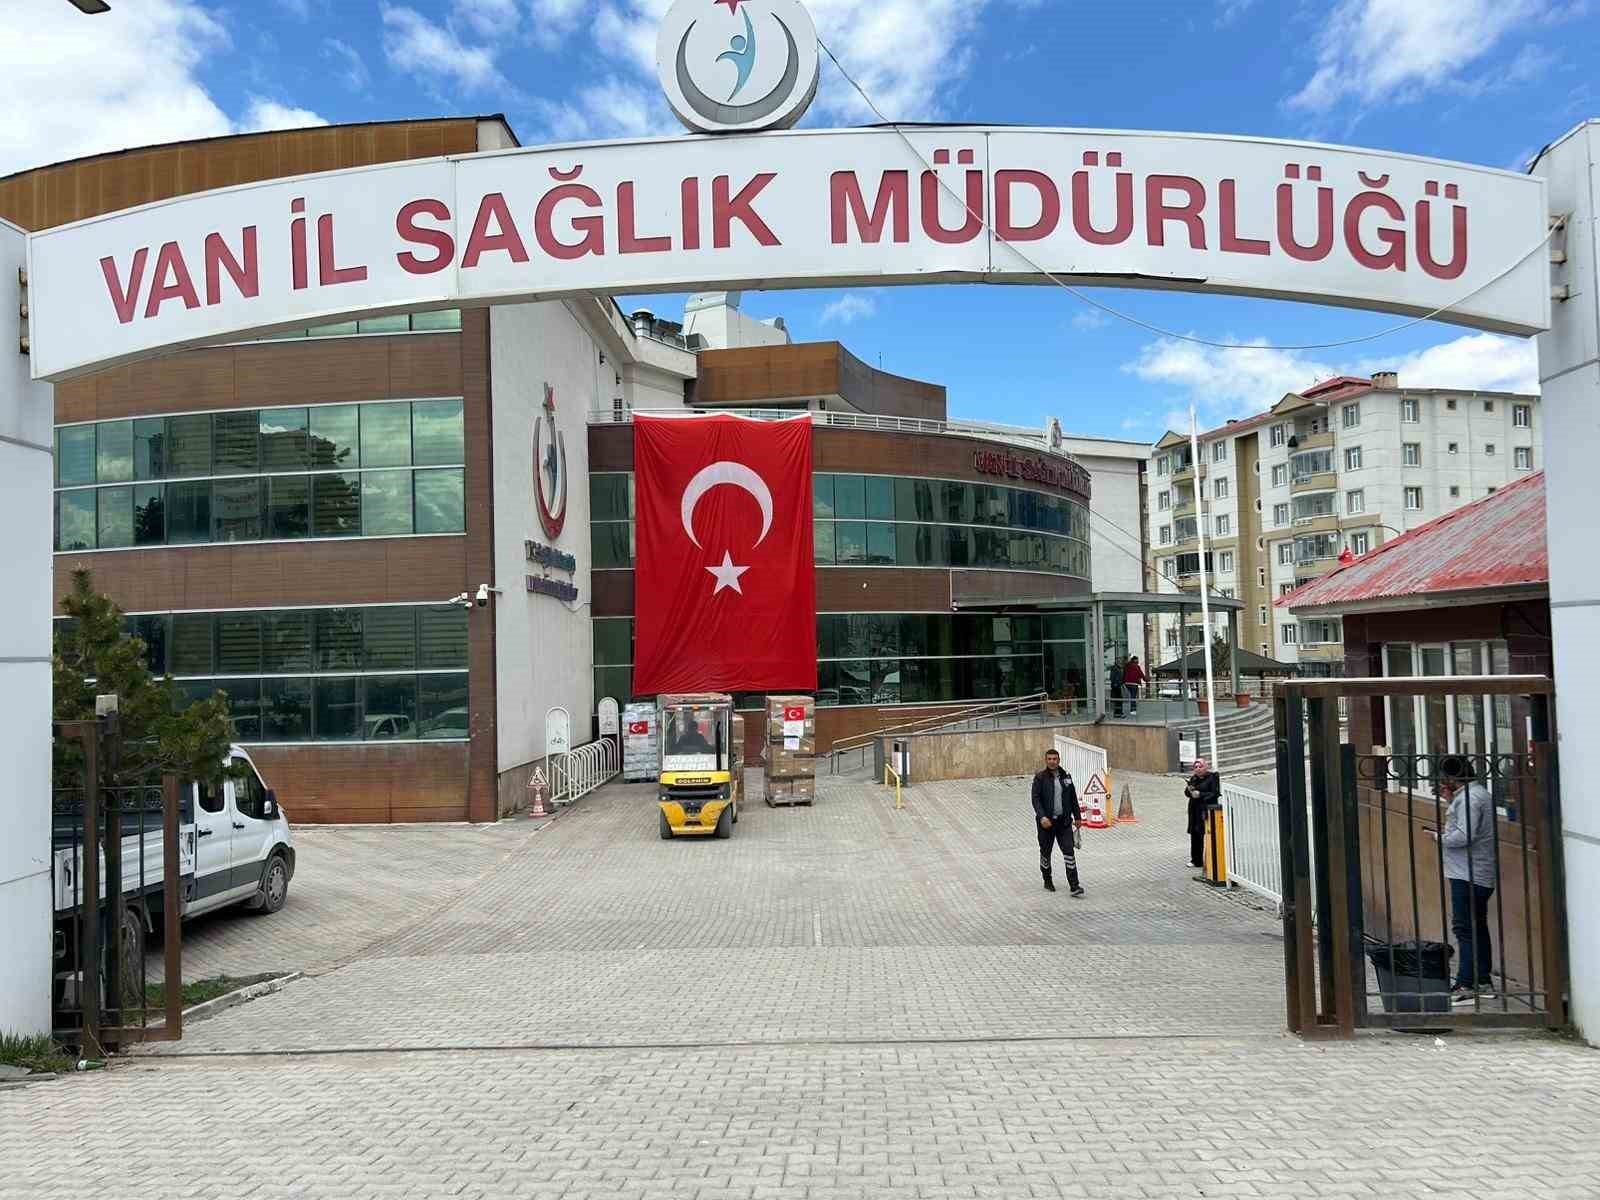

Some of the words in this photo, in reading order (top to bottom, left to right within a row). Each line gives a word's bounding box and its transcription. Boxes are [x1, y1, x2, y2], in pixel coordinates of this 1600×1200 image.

[99, 225, 259, 324] VAN
[290, 197, 369, 290] İL
[395, 164, 782, 275] SAĞLIK
[829, 148, 1468, 280] MÜDÜRLÜĞÜ
